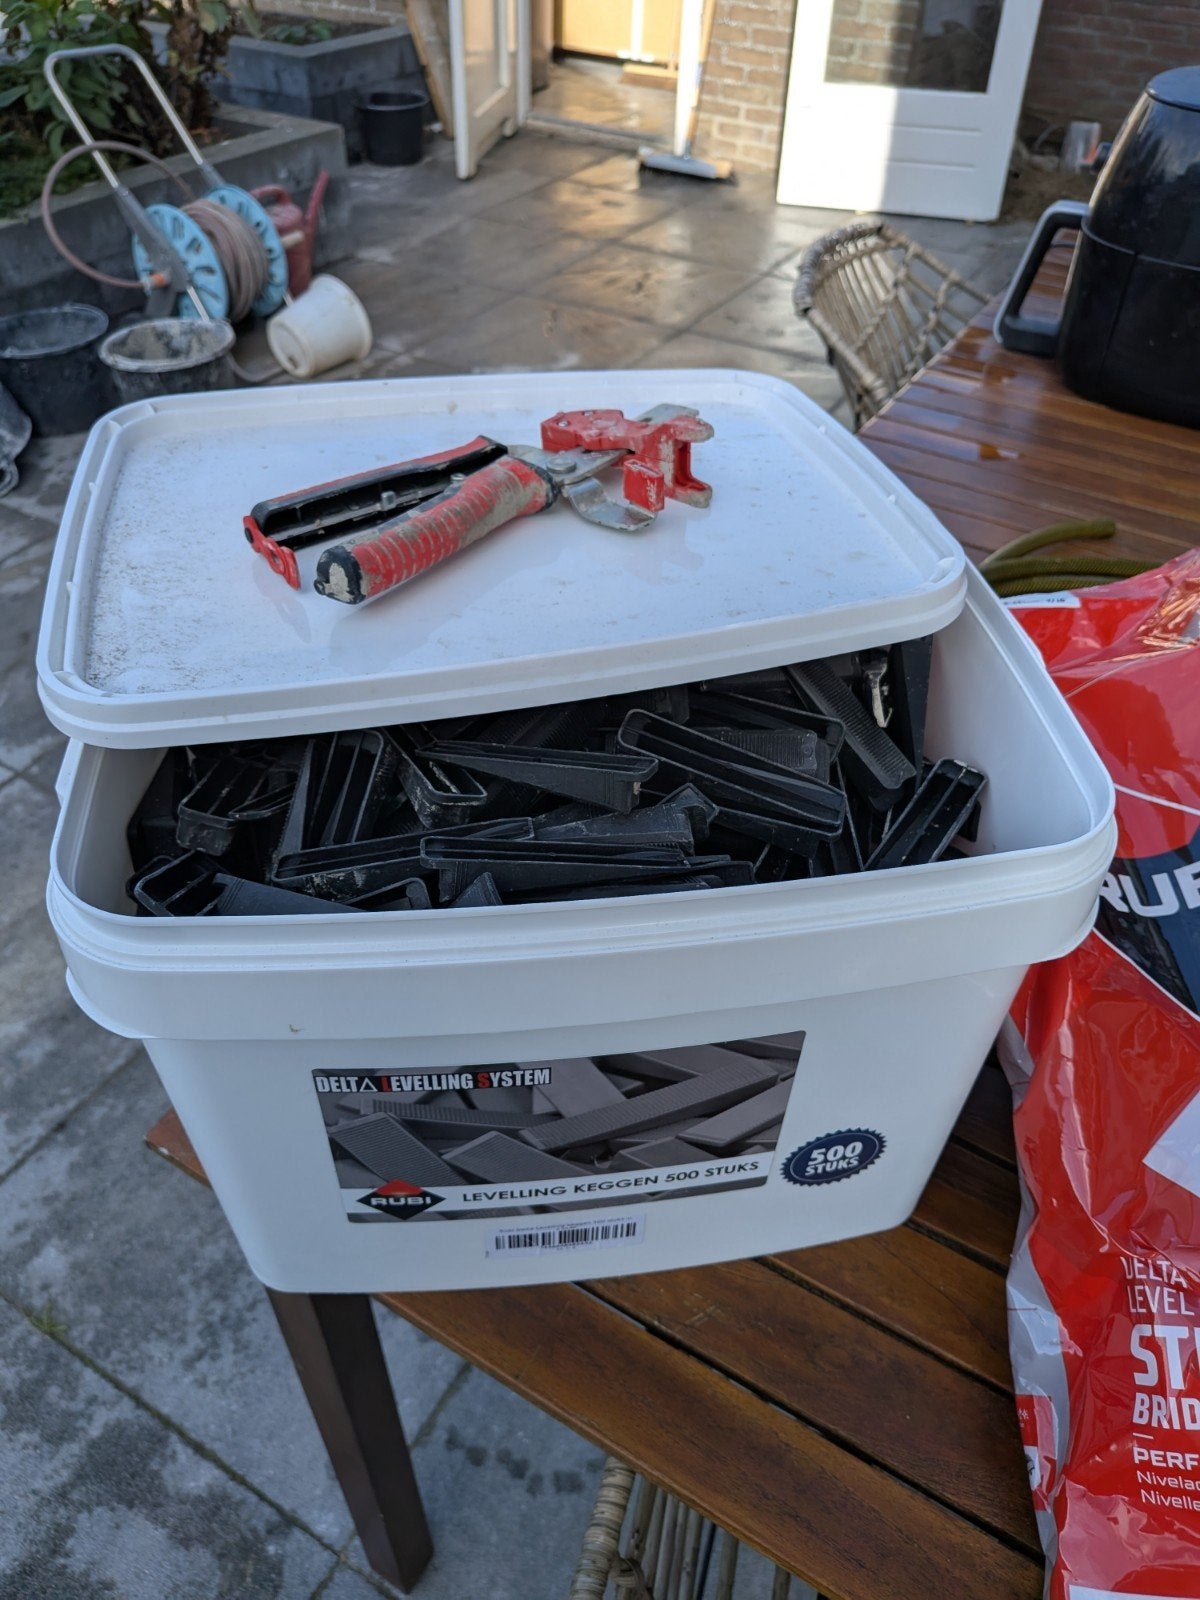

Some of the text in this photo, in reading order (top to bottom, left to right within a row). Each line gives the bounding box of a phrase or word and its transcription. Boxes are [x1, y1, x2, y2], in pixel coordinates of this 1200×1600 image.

[381, 1073, 473, 1092] LEVELLING
[477, 1068, 550, 1088] SYSTEM
[807, 1141, 864, 1166] 500
[804, 1156, 860, 1177] STUKS
[462, 1161, 760, 1202] LEVELLING KEGGEN 500 STUKS
[370, 1196, 432, 1206] RUBI
[1130, 1323, 1200, 1390] ST
